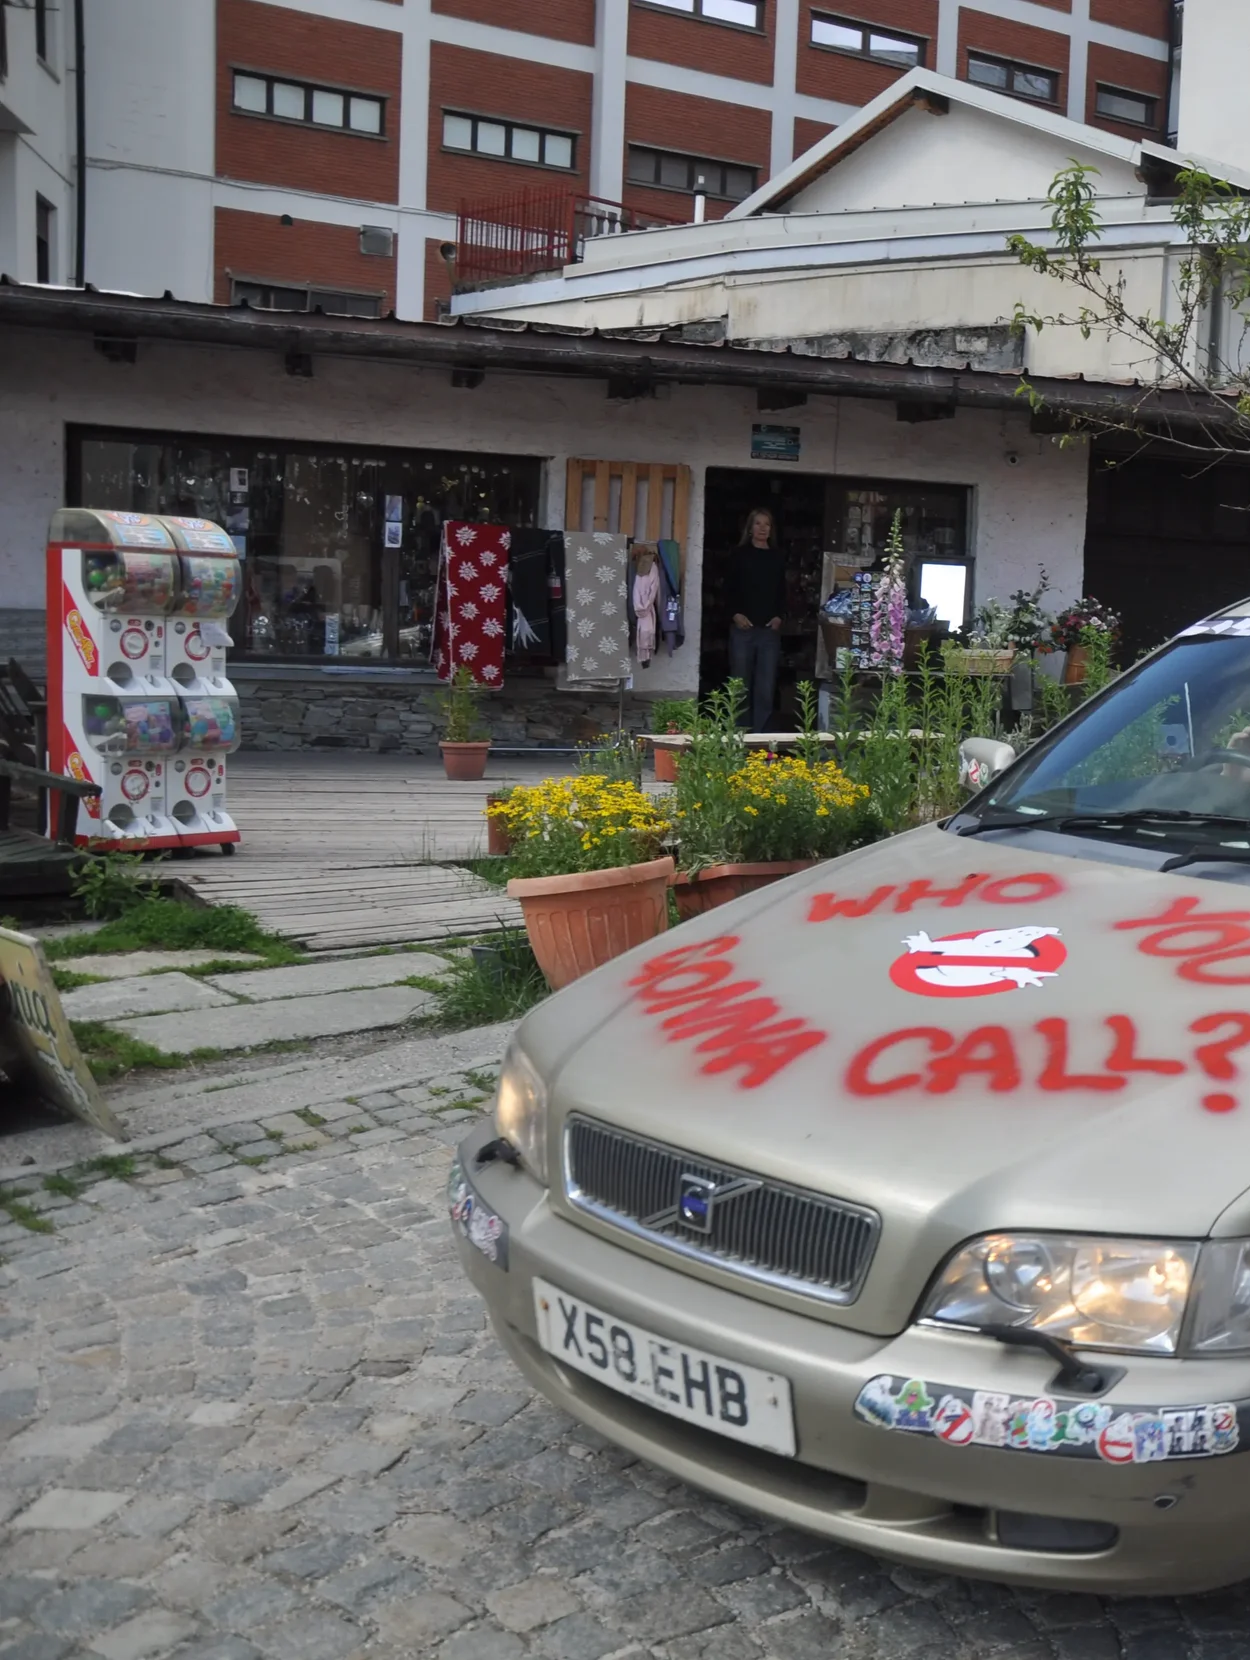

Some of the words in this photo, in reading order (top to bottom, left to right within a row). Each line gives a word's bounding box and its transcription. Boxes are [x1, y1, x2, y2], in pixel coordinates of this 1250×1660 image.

[806, 872, 1068, 922] WHO
[627, 934, 827, 1089] GONNA
[558, 1297, 637, 1384] X58
[650, 1340, 749, 1428] EHB
